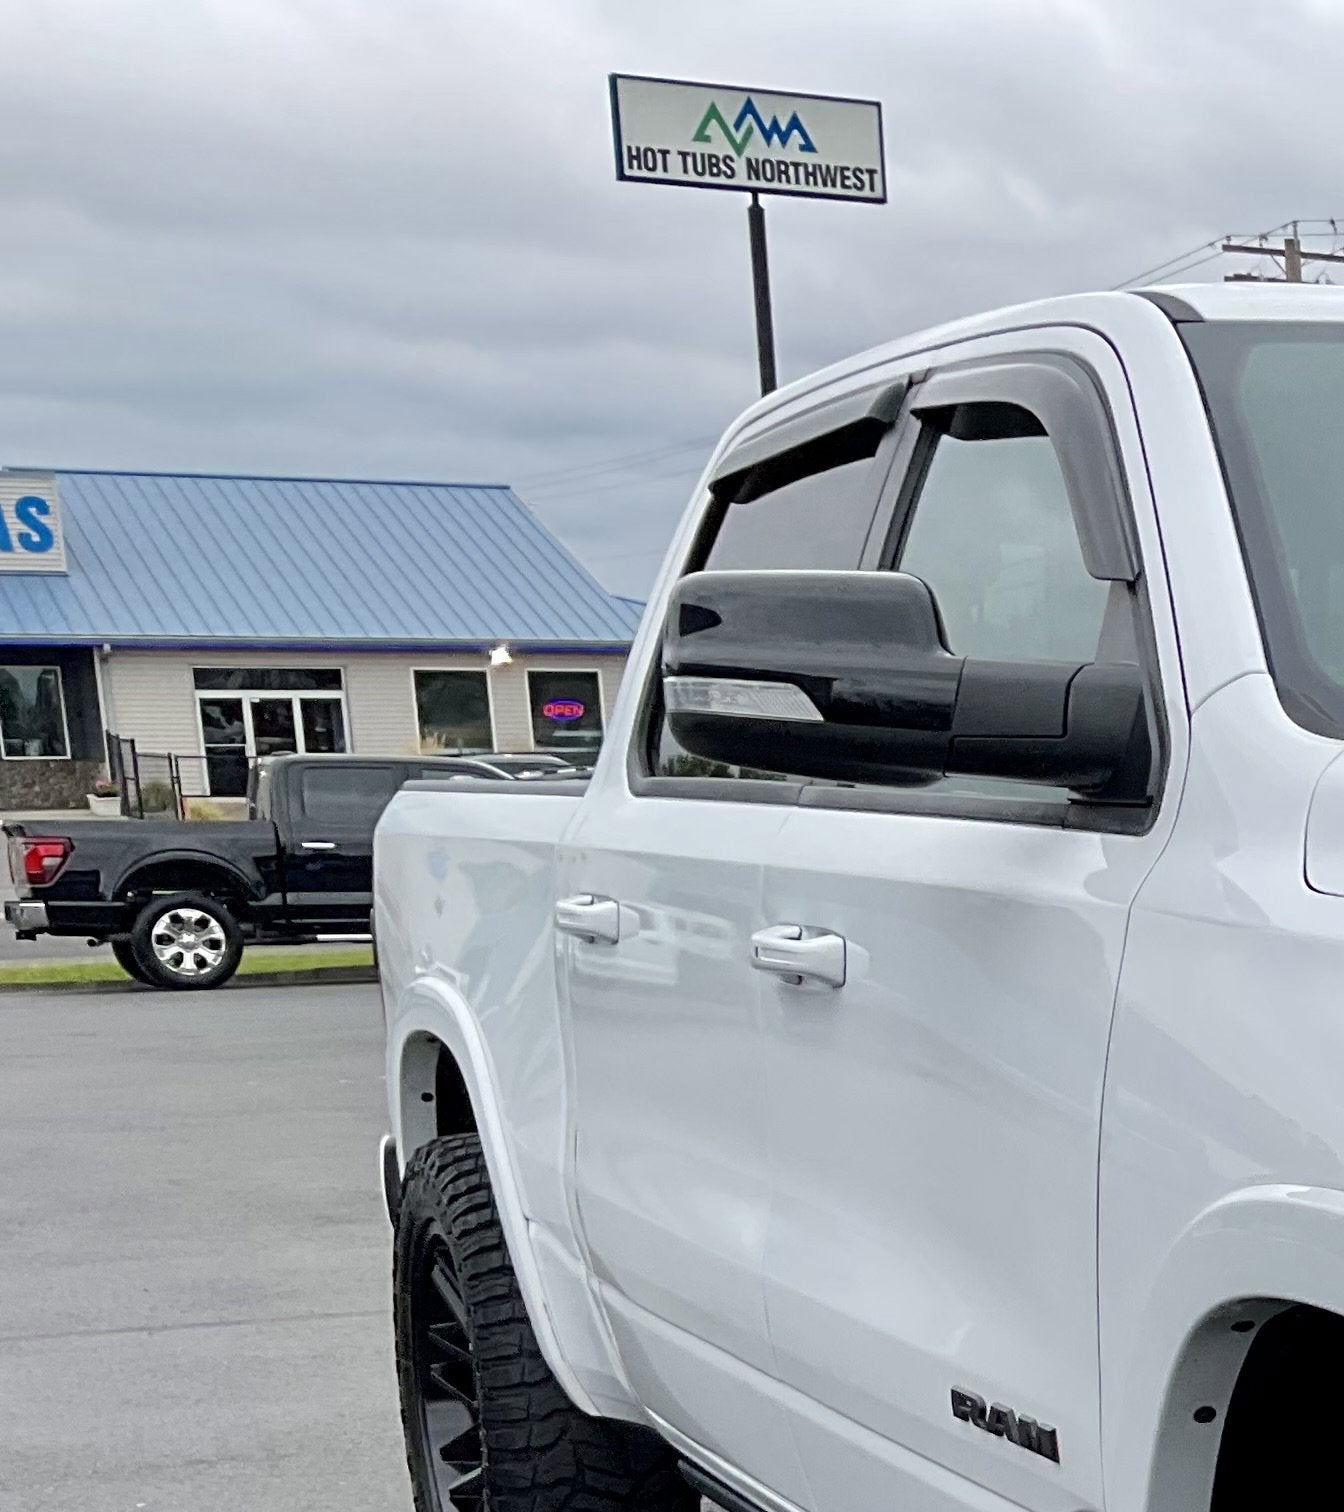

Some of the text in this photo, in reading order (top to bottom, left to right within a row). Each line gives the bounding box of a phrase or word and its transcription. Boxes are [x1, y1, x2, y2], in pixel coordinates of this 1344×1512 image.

[626, 145, 878, 193] HOT TUBS NORTHWEST
[543, 704, 585, 717] OPEN
[950, 1384, 1061, 1465] RAM
